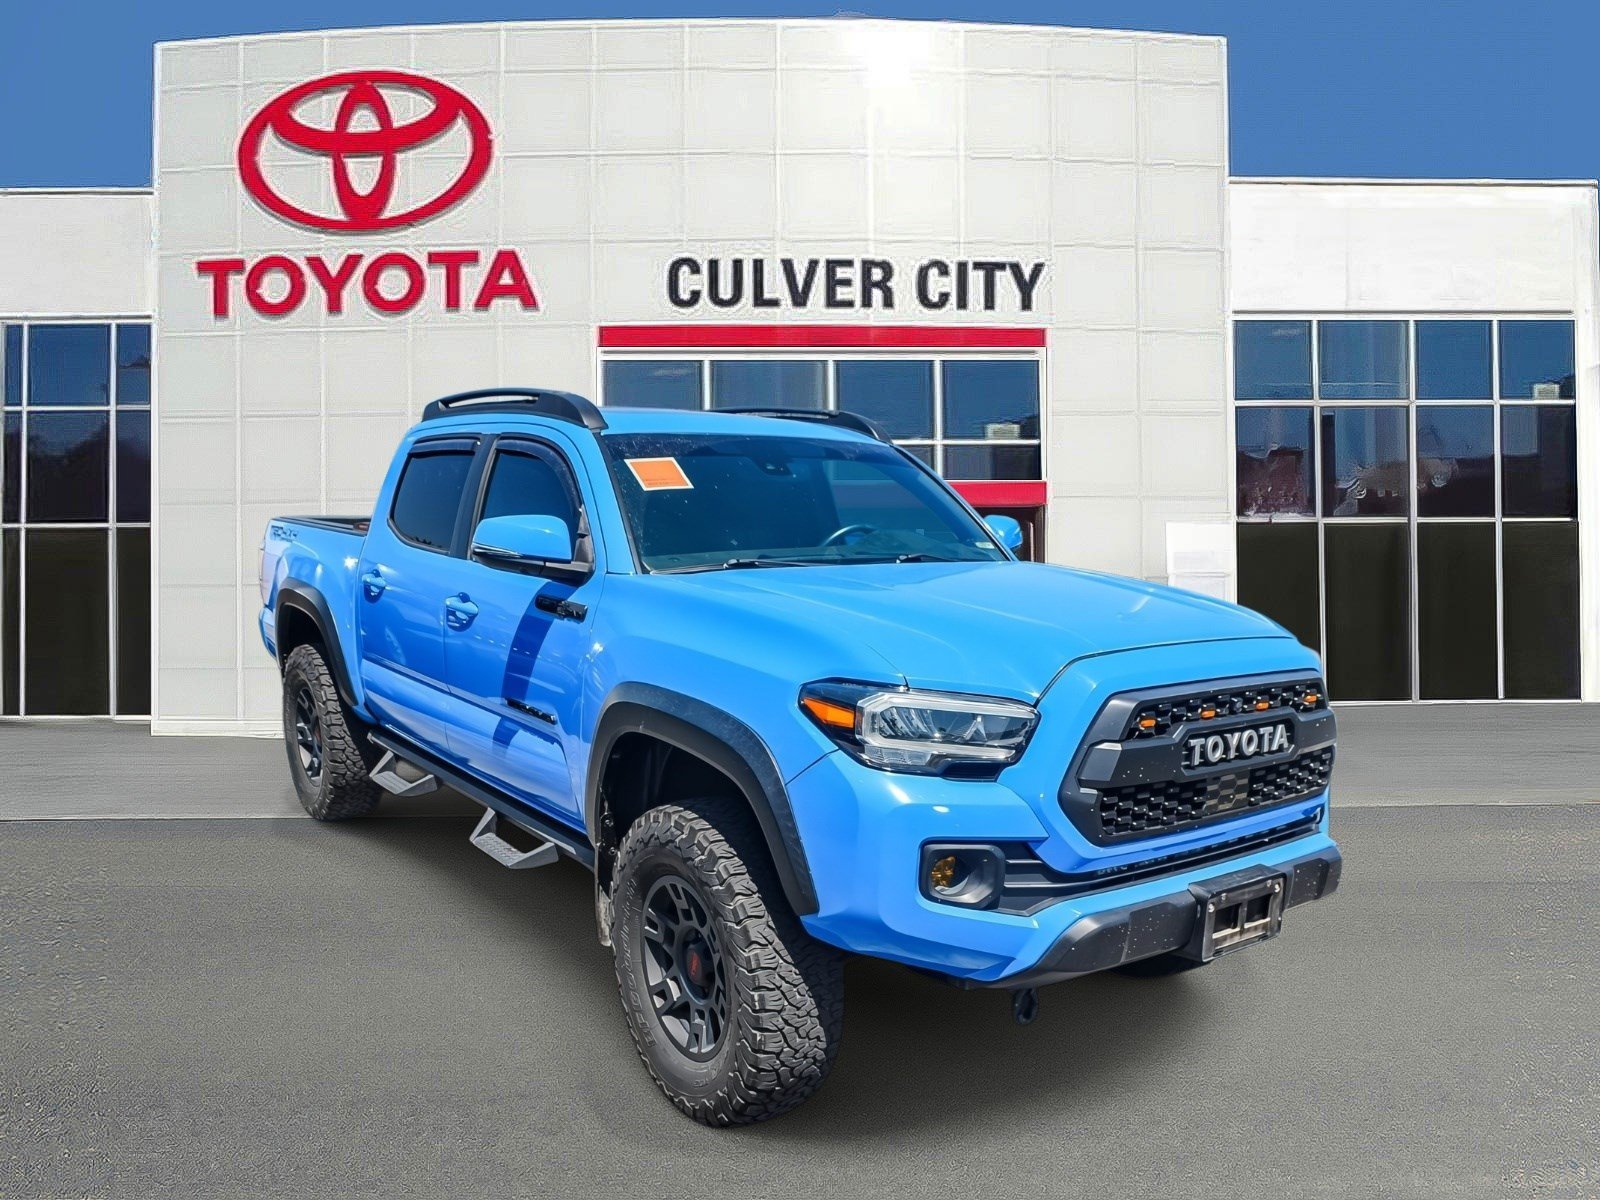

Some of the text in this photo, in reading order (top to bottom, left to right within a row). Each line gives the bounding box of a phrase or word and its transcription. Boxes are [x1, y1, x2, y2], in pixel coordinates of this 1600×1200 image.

[195, 249, 540, 319] TOYOTA
[667, 256, 1046, 311] CULVER CITY
[1188, 724, 1289, 766] TOYOTA
